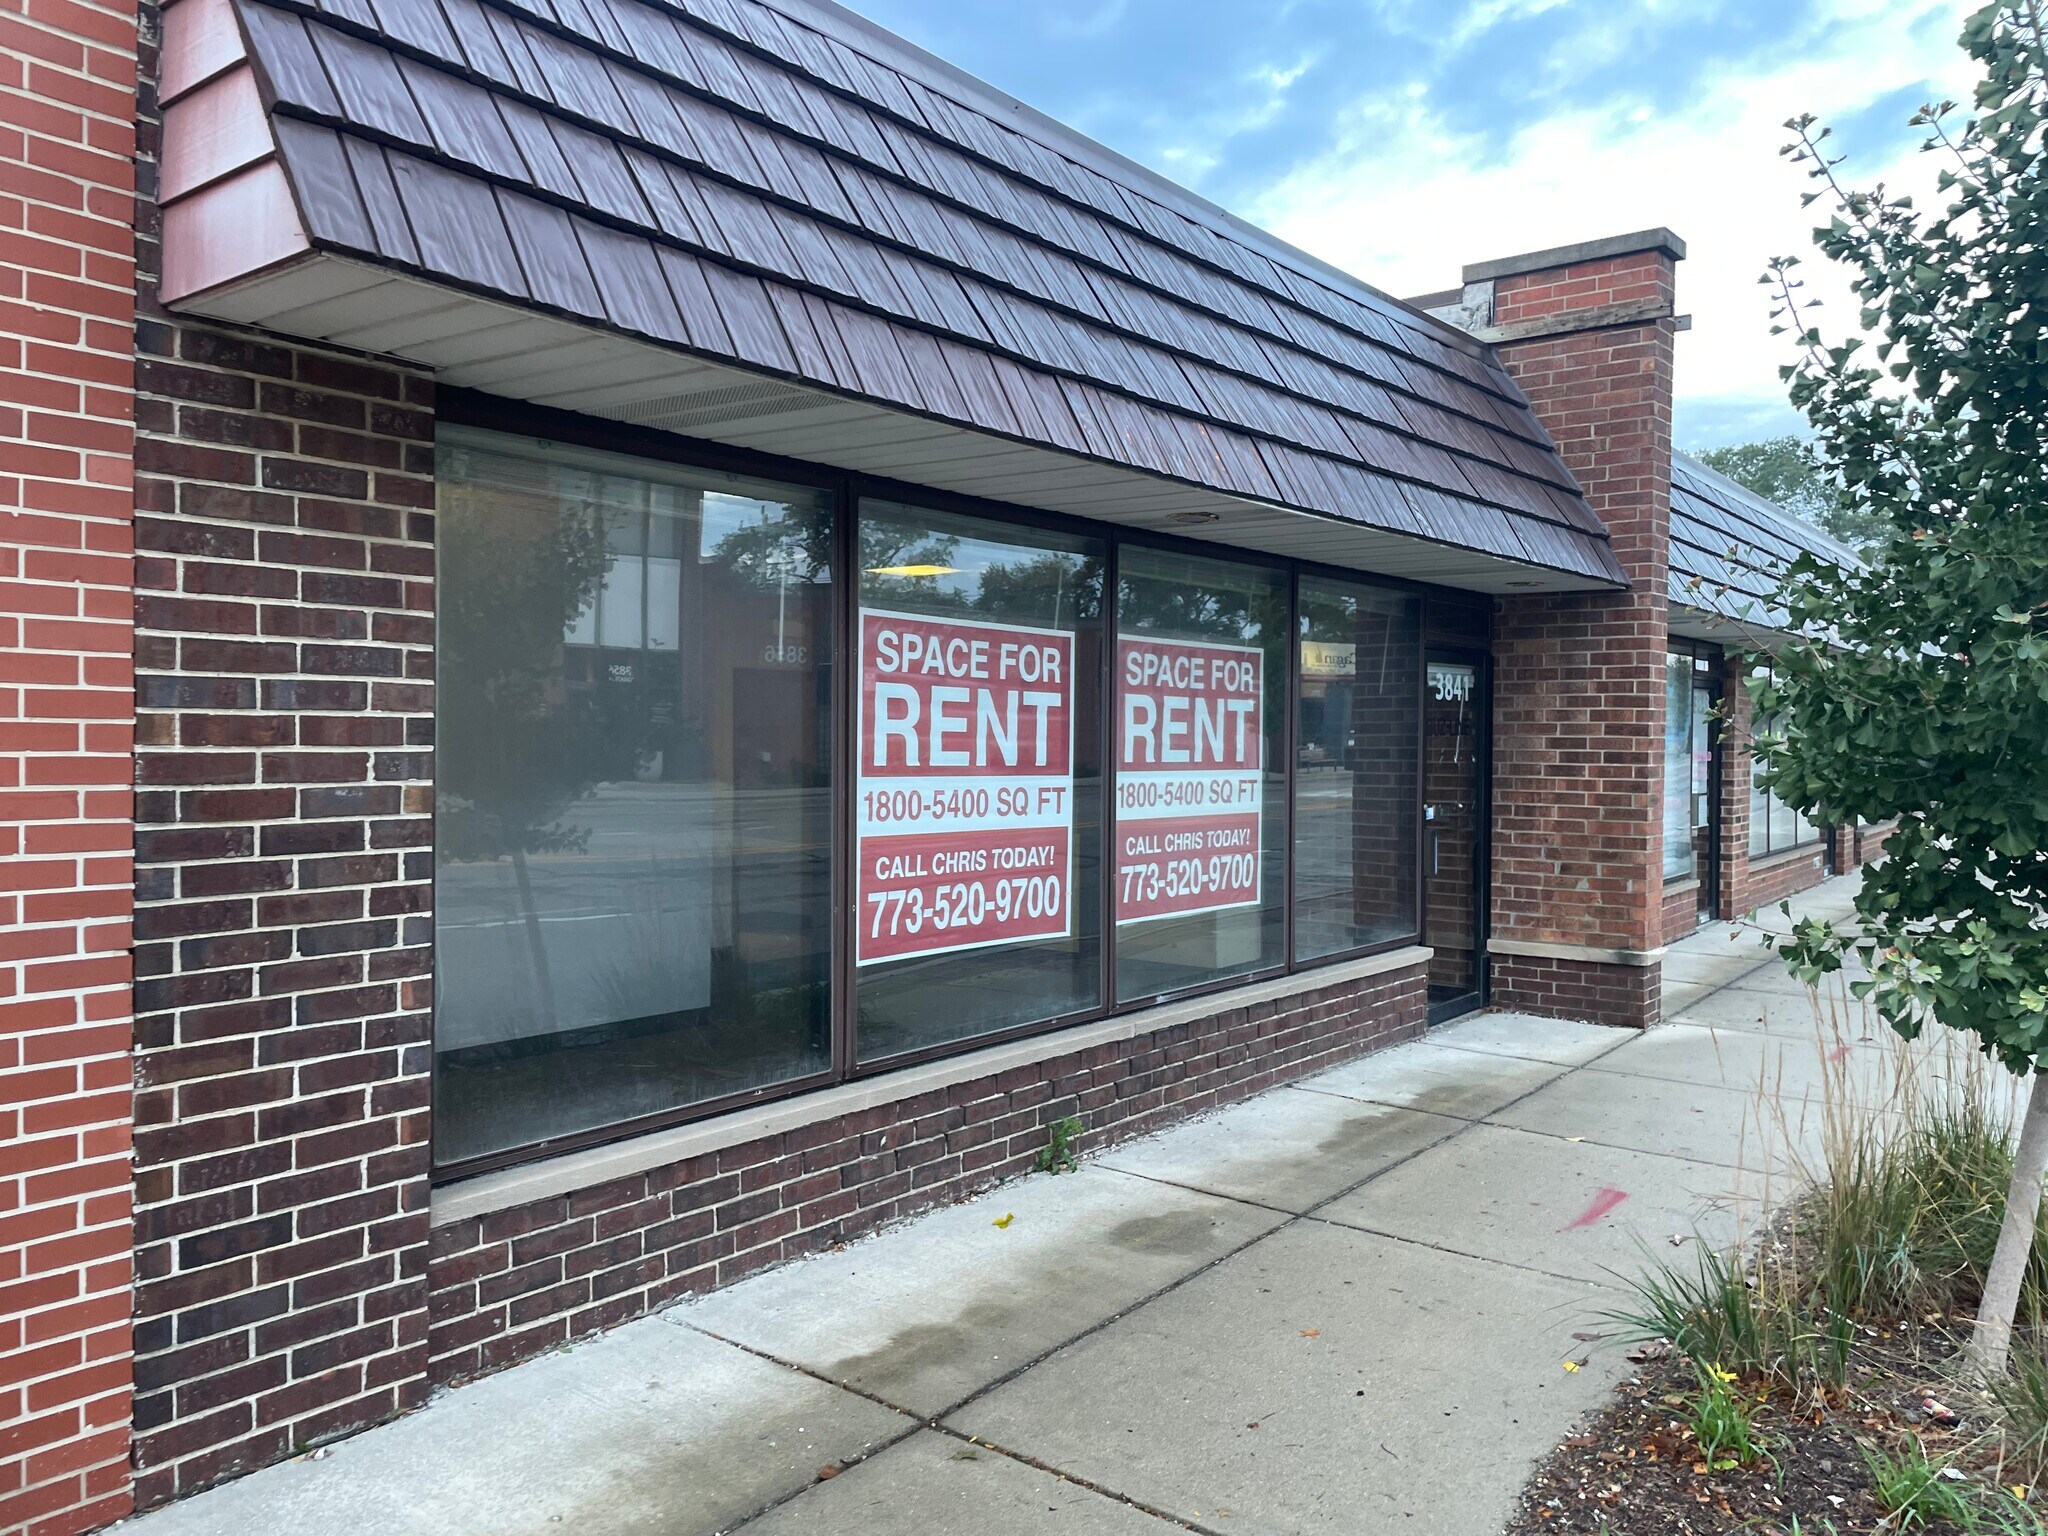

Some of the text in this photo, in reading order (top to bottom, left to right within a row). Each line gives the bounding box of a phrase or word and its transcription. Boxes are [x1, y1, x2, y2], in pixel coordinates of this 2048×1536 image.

[876, 630, 1061, 683] SPACE FOR
[1126, 651, 1253, 692] SPACE FOR
[1435, 672, 1469, 702] 3841
[873, 681, 1062, 767] RENT
[1124, 693, 1254, 763] RENT
[864, 786, 1066, 822] 1800-5400 SQ FT
[1118, 779, 1257, 808] 1800-5400 SQ FT
[876, 846, 1054, 880] CALL CHRIS TODAY!
[1126, 829, 1250, 856] CALL CHRIS TODAY!
[1121, 853, 1253, 903] 773-520-9700
[868, 875, 1060, 938] 773-520-9700
